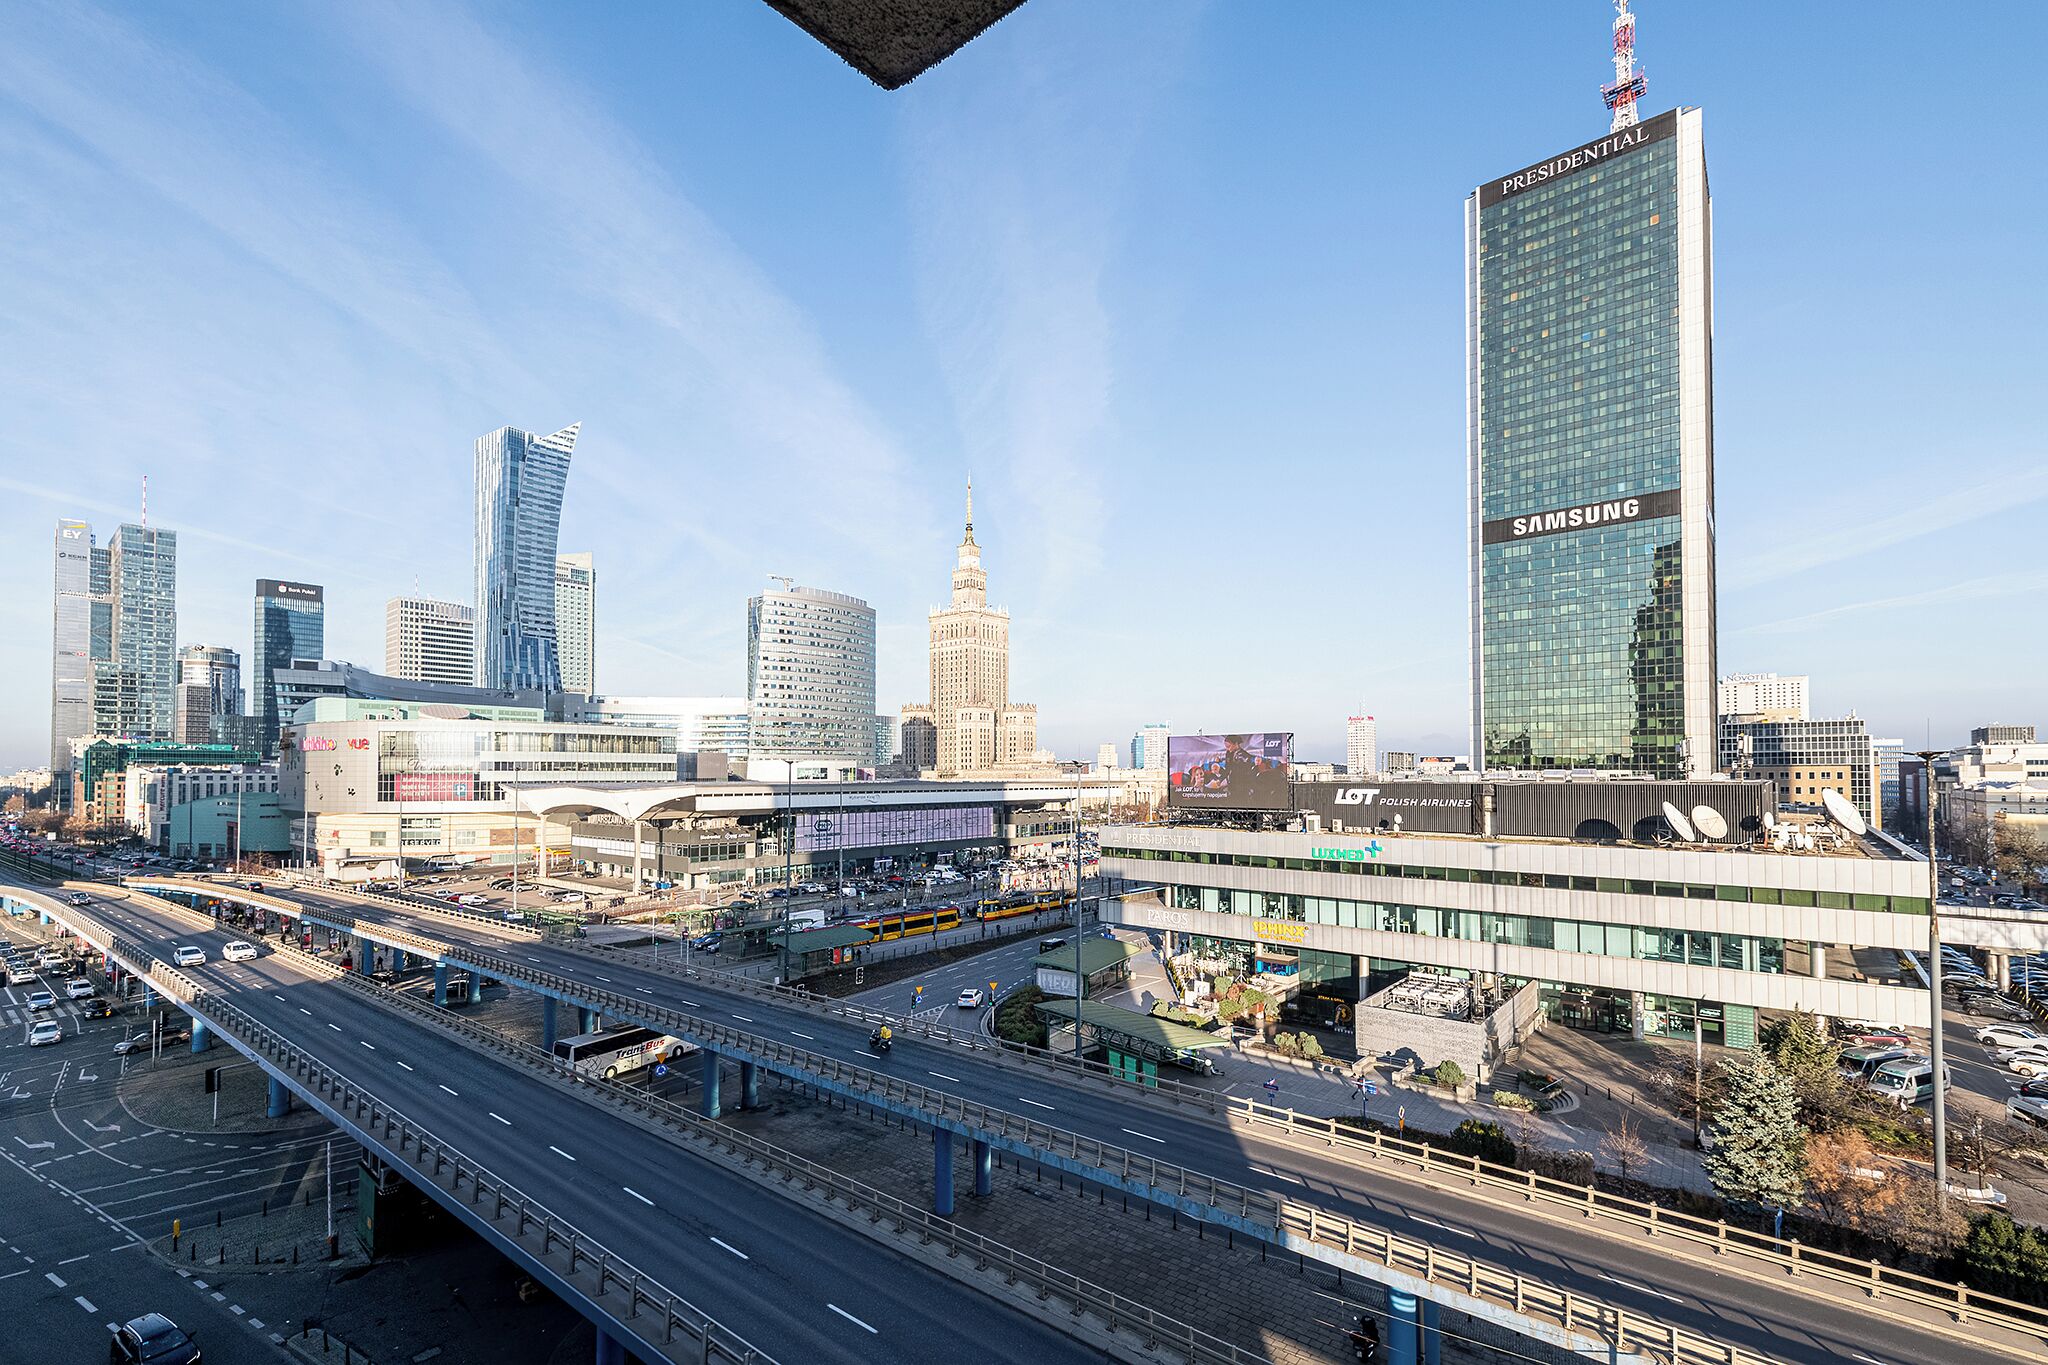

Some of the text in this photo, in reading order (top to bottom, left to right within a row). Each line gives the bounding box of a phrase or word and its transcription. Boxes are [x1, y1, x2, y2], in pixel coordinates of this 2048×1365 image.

[1502, 126, 1649, 195] PRESIDENTIAL
[1513, 499, 1639, 535] SAMSUNG
[63, 529, 81, 540] EY
[302, 588, 316, 596] Polski
[1726, 672, 1773, 682] NOVOTEL
[347, 738, 370, 751] vue
[1265, 740, 1281, 748] LOT
[1334, 788, 1472, 808] LOT POLISH AIRLINES
[1126, 832, 1201, 847] PRESIDENTIAL
[1311, 847, 1365, 861] LUXMED
[1147, 909, 1188, 926] PAROS
[1252, 920, 1305, 938] SPHINX
[615, 1038, 665, 1059] TransBus
